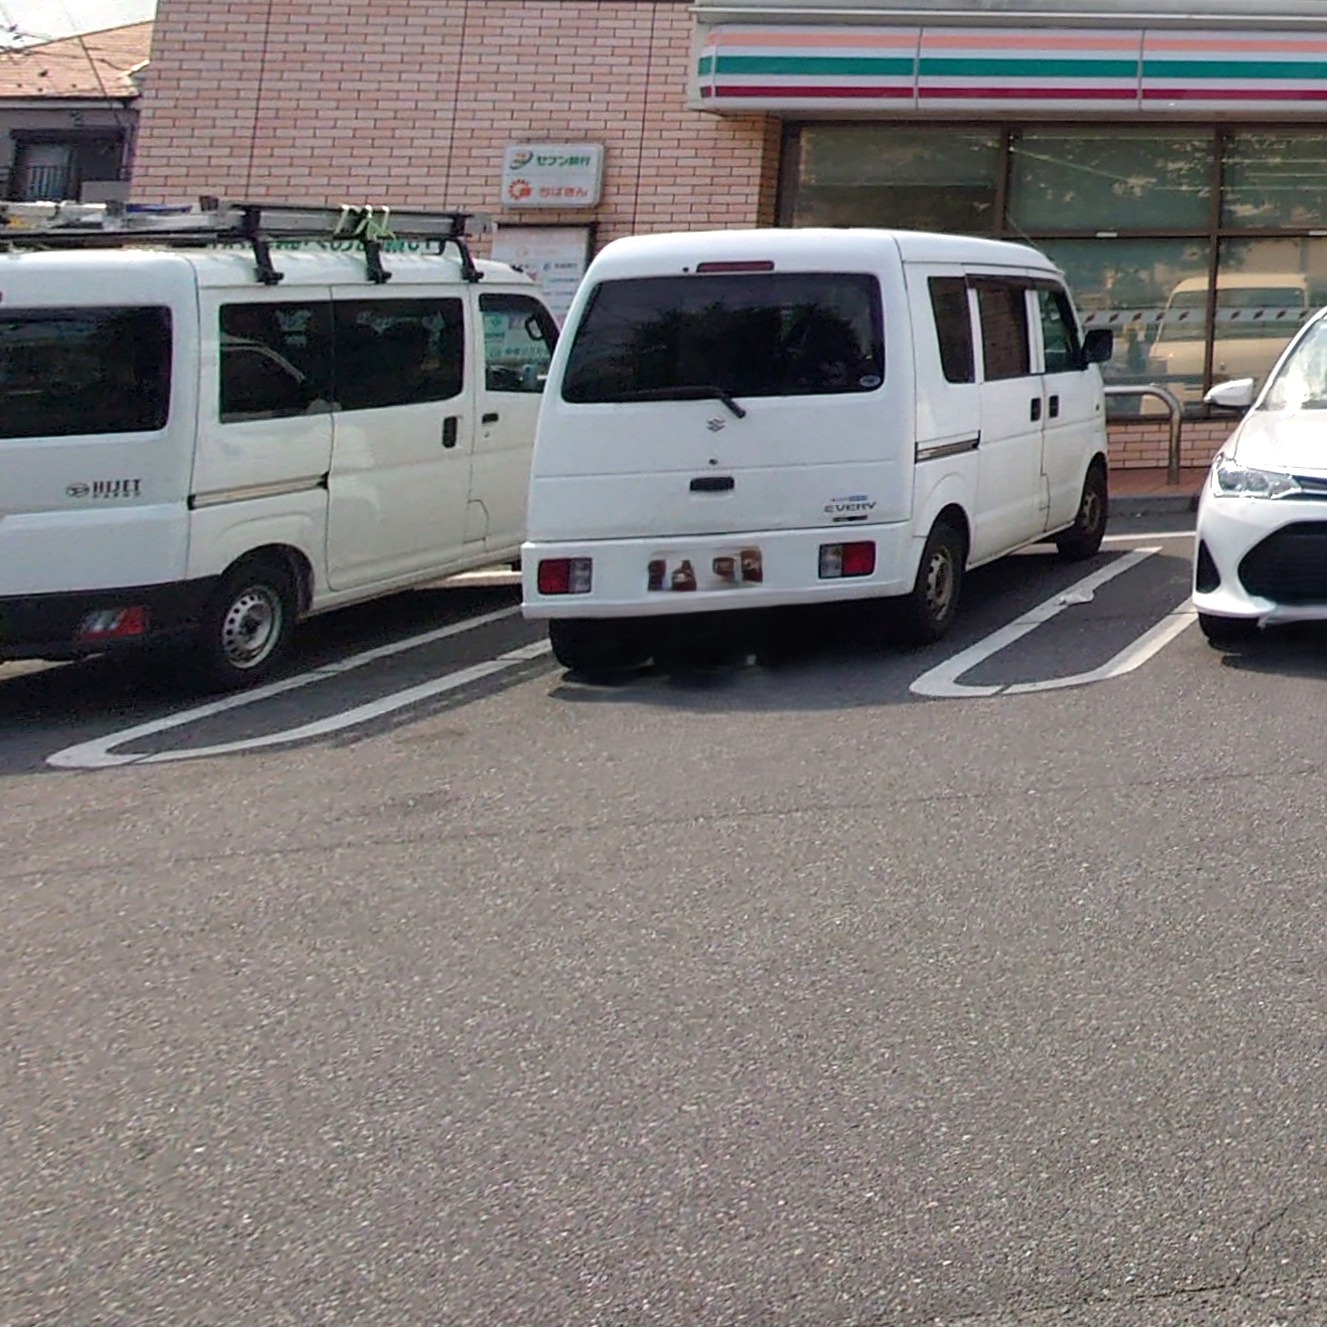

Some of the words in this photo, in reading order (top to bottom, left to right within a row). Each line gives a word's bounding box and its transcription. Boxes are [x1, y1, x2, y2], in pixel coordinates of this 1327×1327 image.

[537, 155, 591, 167] セブン銀行
[93, 479, 141, 494] HIJET
